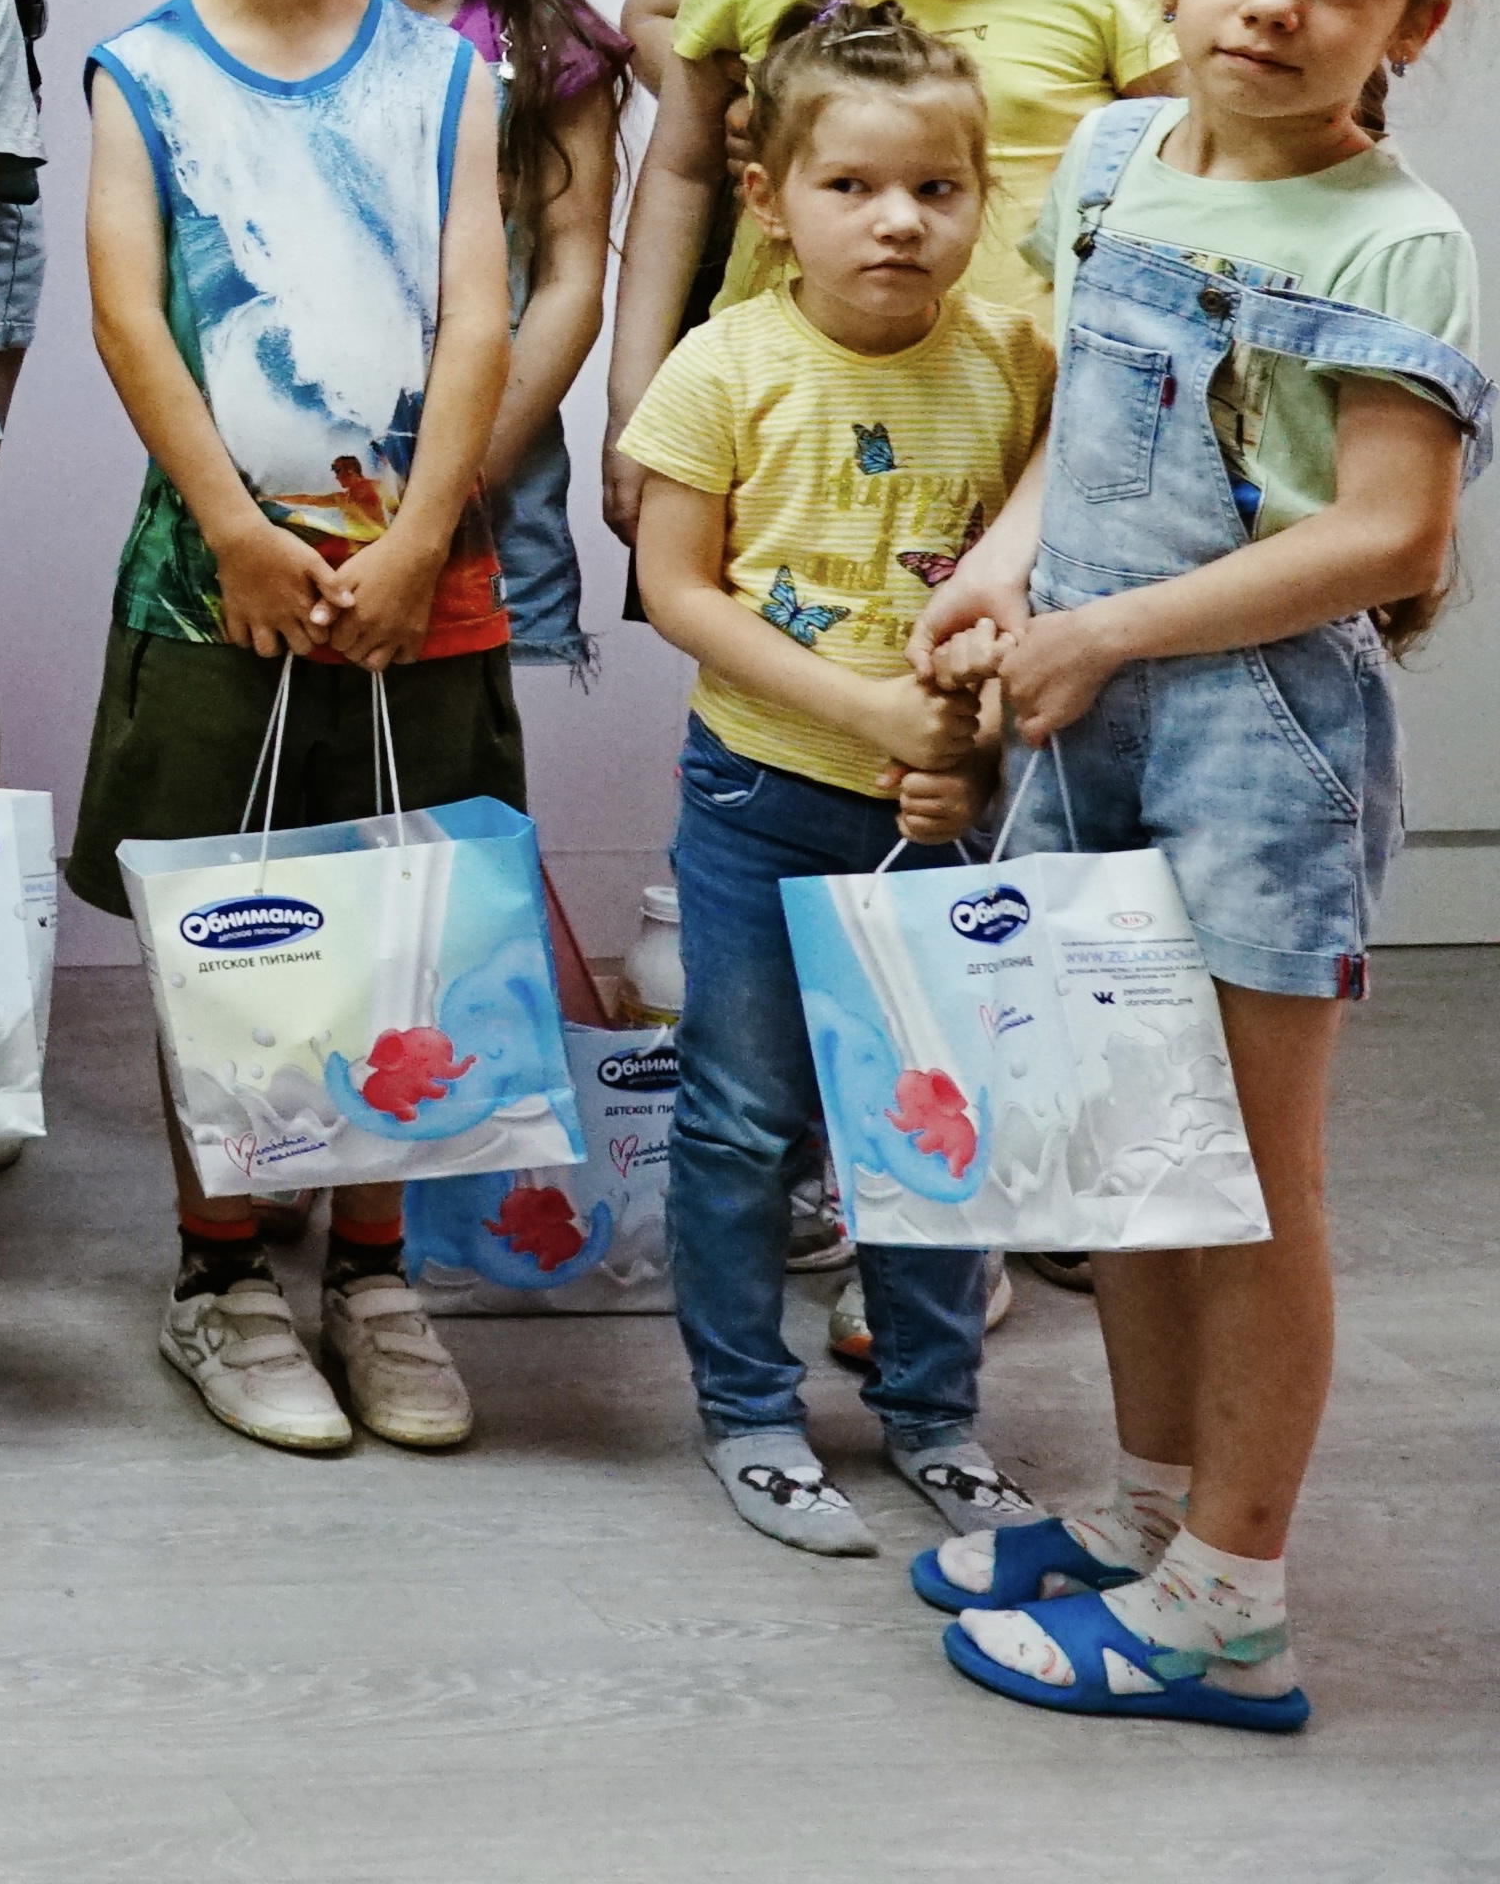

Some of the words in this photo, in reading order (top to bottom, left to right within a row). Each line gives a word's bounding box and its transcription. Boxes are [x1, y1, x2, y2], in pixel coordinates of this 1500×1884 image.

[182, 907, 321, 940] Обнимама
[198, 953, 256, 974] ДЕТСКОЕ
[259, 949, 323, 967] ПИТАНИЕ
[605, 1105, 654, 1116] ДЕТСКОЕ
